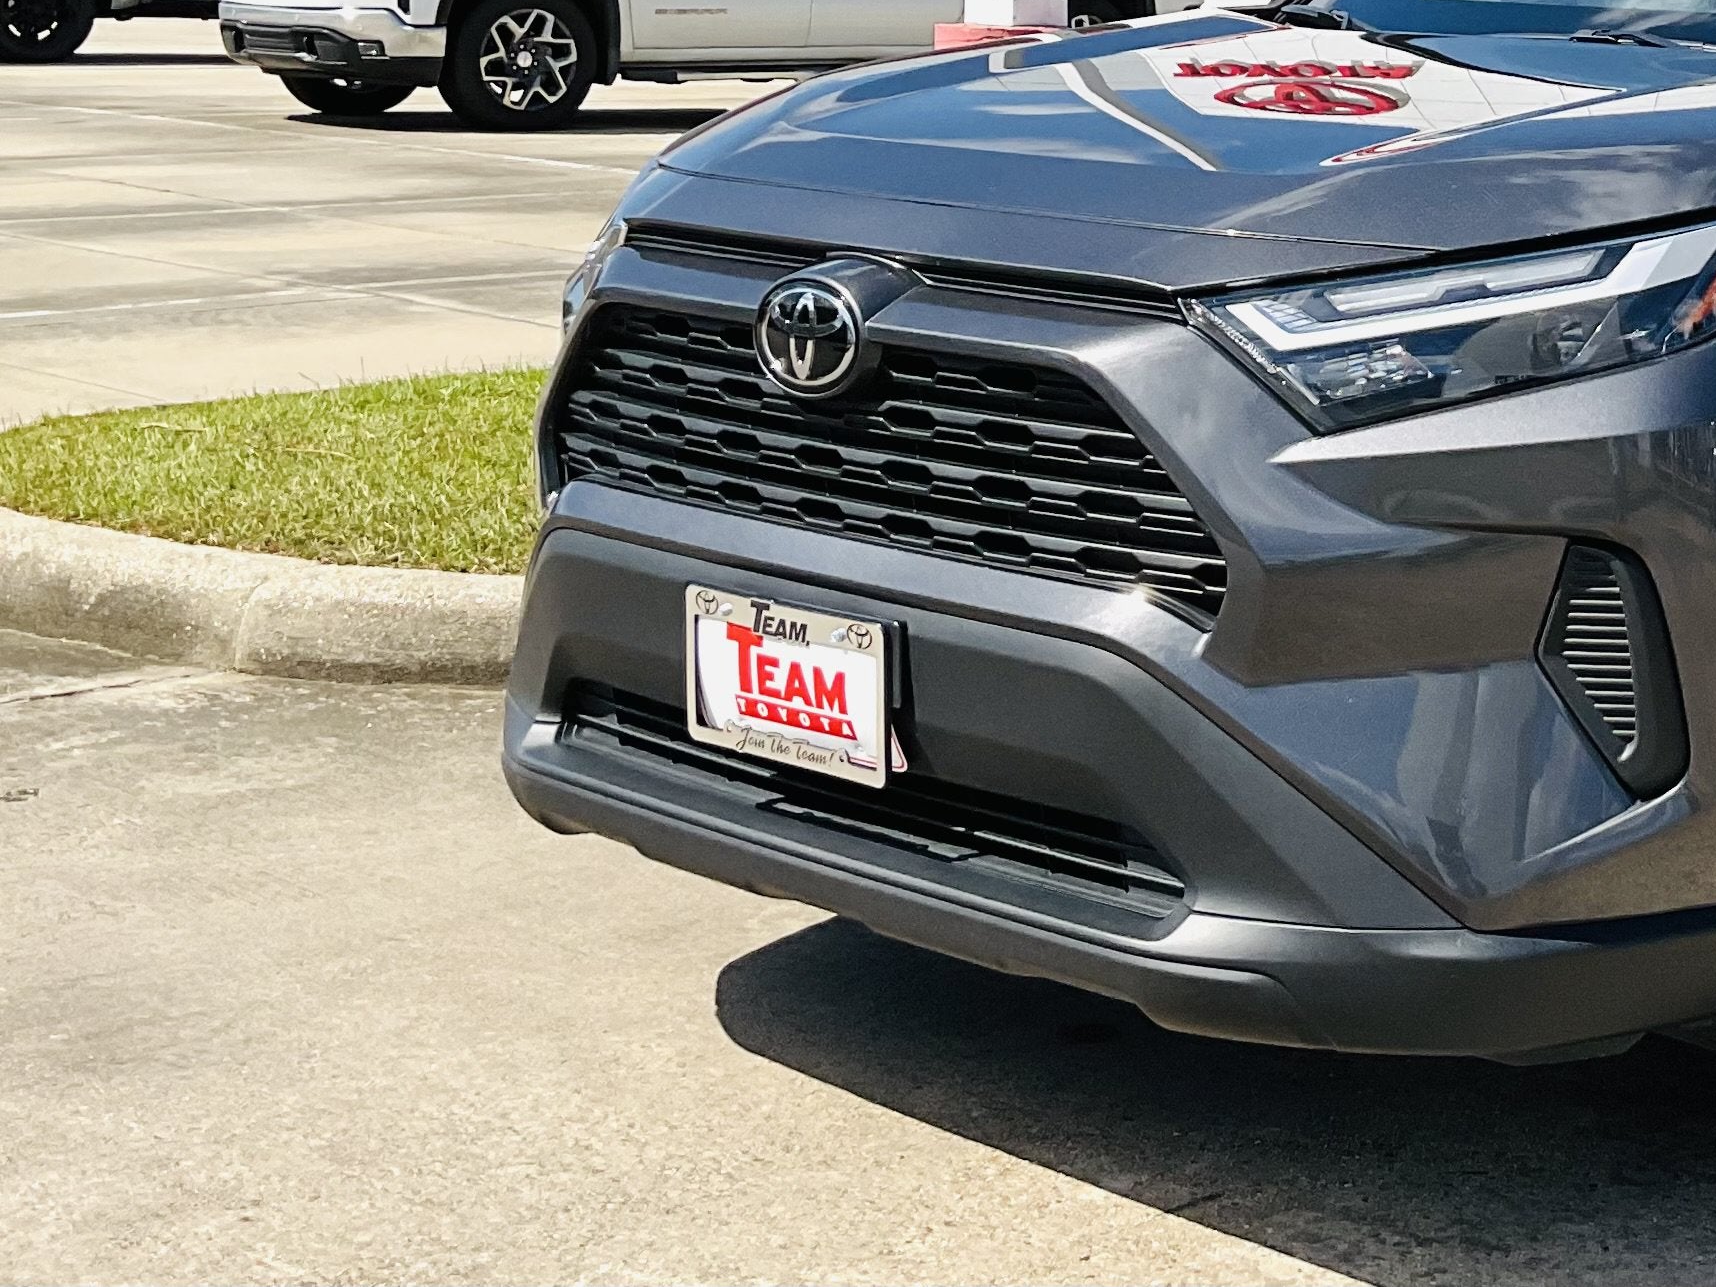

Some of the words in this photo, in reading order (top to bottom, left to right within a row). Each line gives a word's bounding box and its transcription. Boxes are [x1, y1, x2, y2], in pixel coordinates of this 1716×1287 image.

[726, 621, 849, 715] TEAM
[736, 697, 854, 737] TOYOTA
[735, 725, 766, 751] Join
